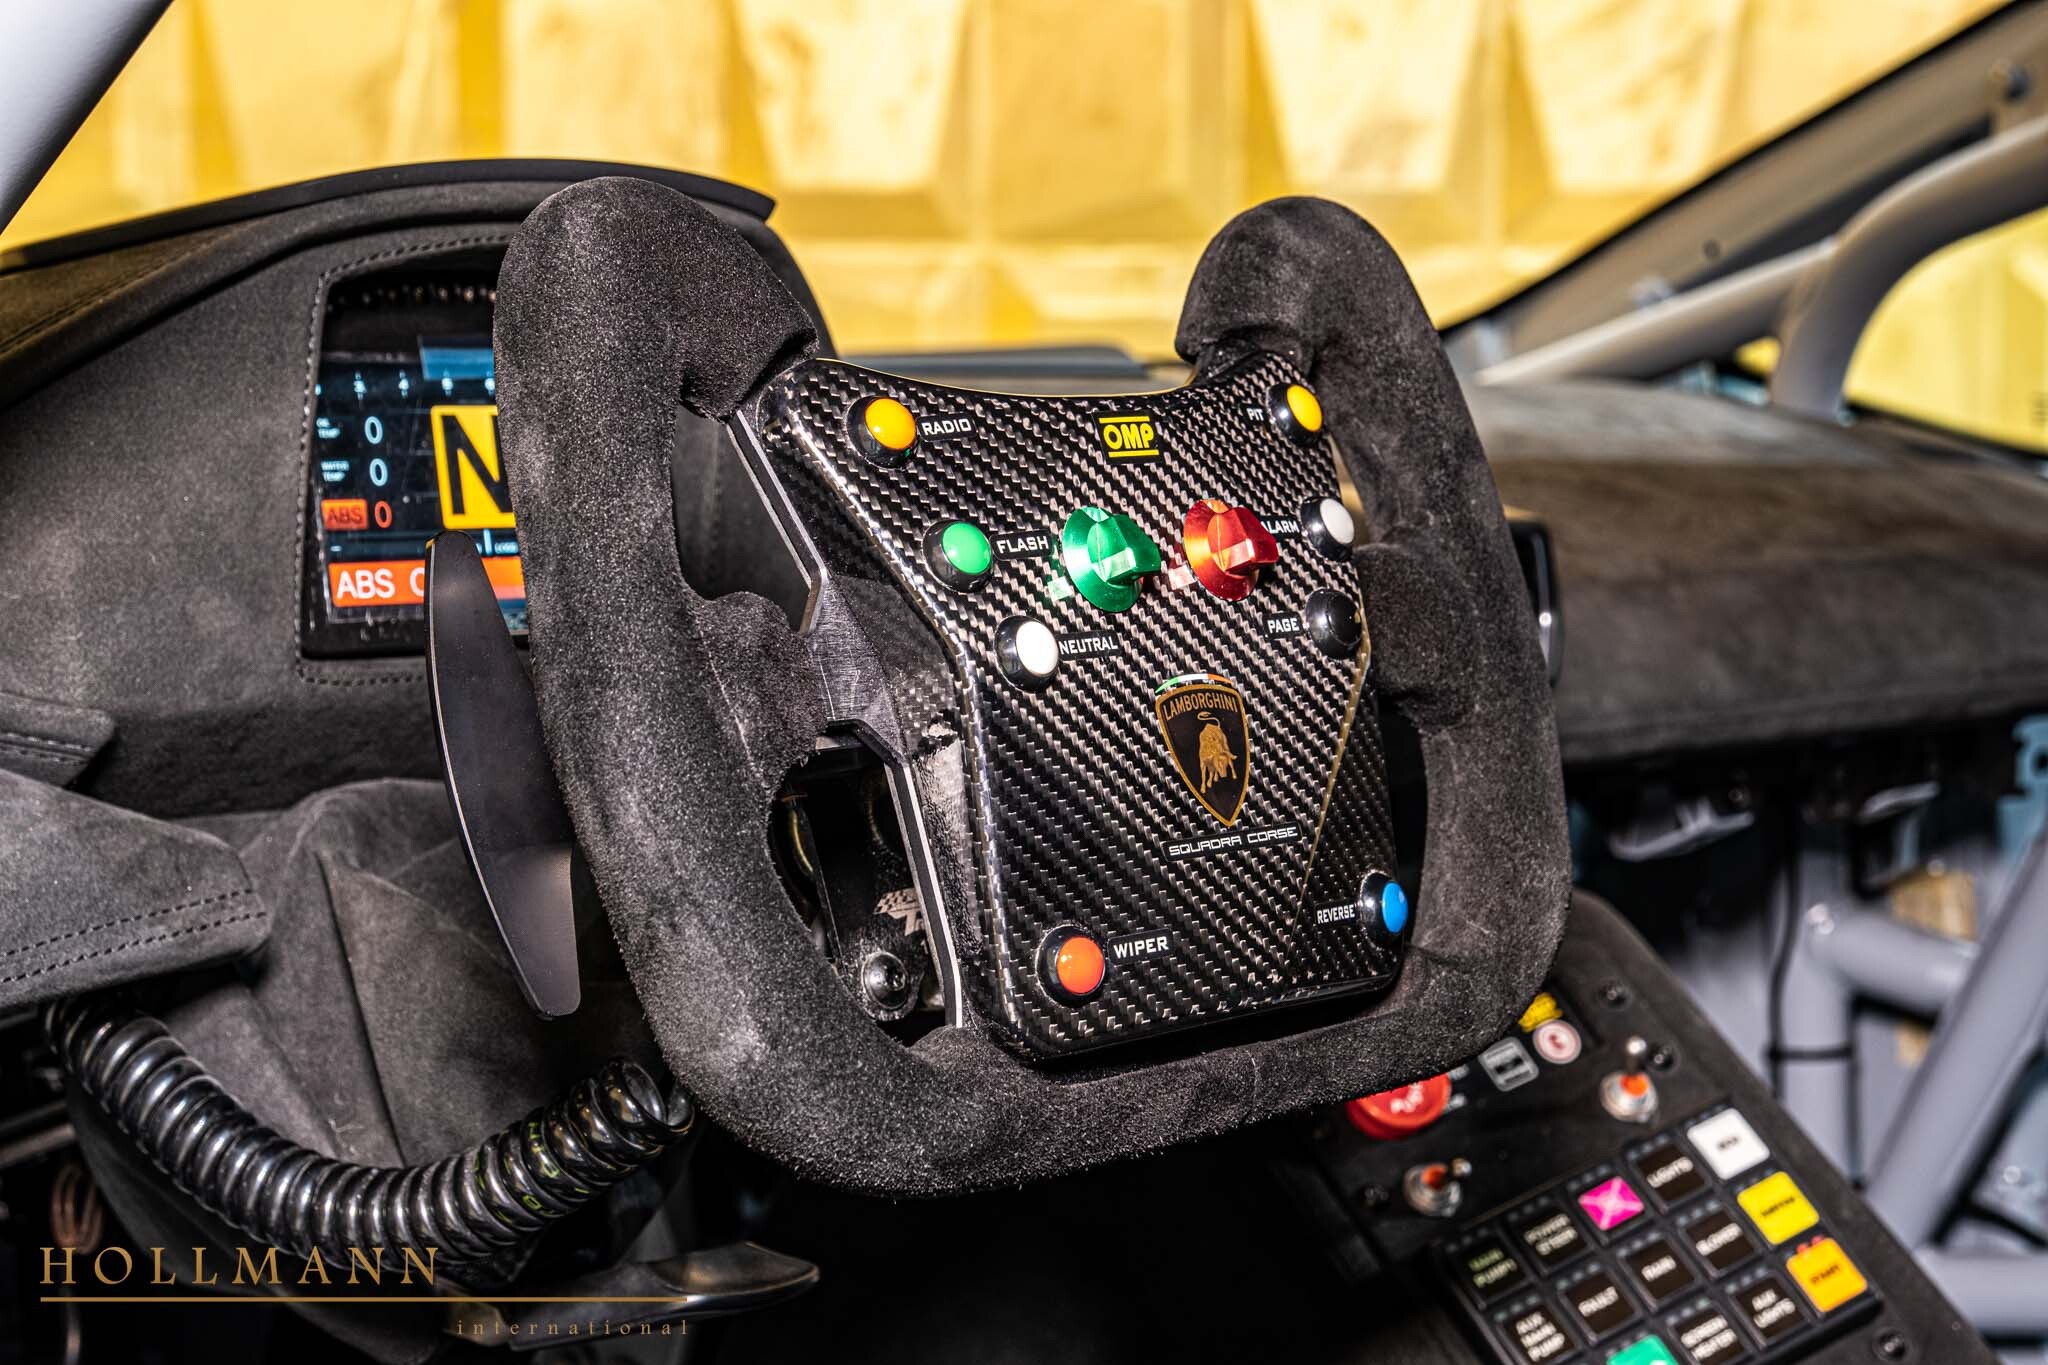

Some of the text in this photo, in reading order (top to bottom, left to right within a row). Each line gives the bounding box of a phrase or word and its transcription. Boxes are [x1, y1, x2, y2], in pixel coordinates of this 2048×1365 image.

[922, 418, 972, 436] RADIO
[1246, 407, 1264, 421] PIT
[364, 415, 384, 445] 0
[1103, 422, 1154, 450] OMP
[369, 458, 388, 487] 0
[441, 414, 513, 514] N
[327, 500, 393, 529] ABS 0
[996, 535, 1049, 553] FLASH
[336, 568, 396, 600] ABS
[1267, 617, 1299, 634] PAGE
[1058, 634, 1118, 654] NEUTRAL
[1163, 692, 1238, 721] LAMBORGHINI
[1169, 826, 1298, 856] SQUADRA CORSE
[1317, 906, 1355, 924] REVERSE
[1114, 935, 1168, 959] WIPER
